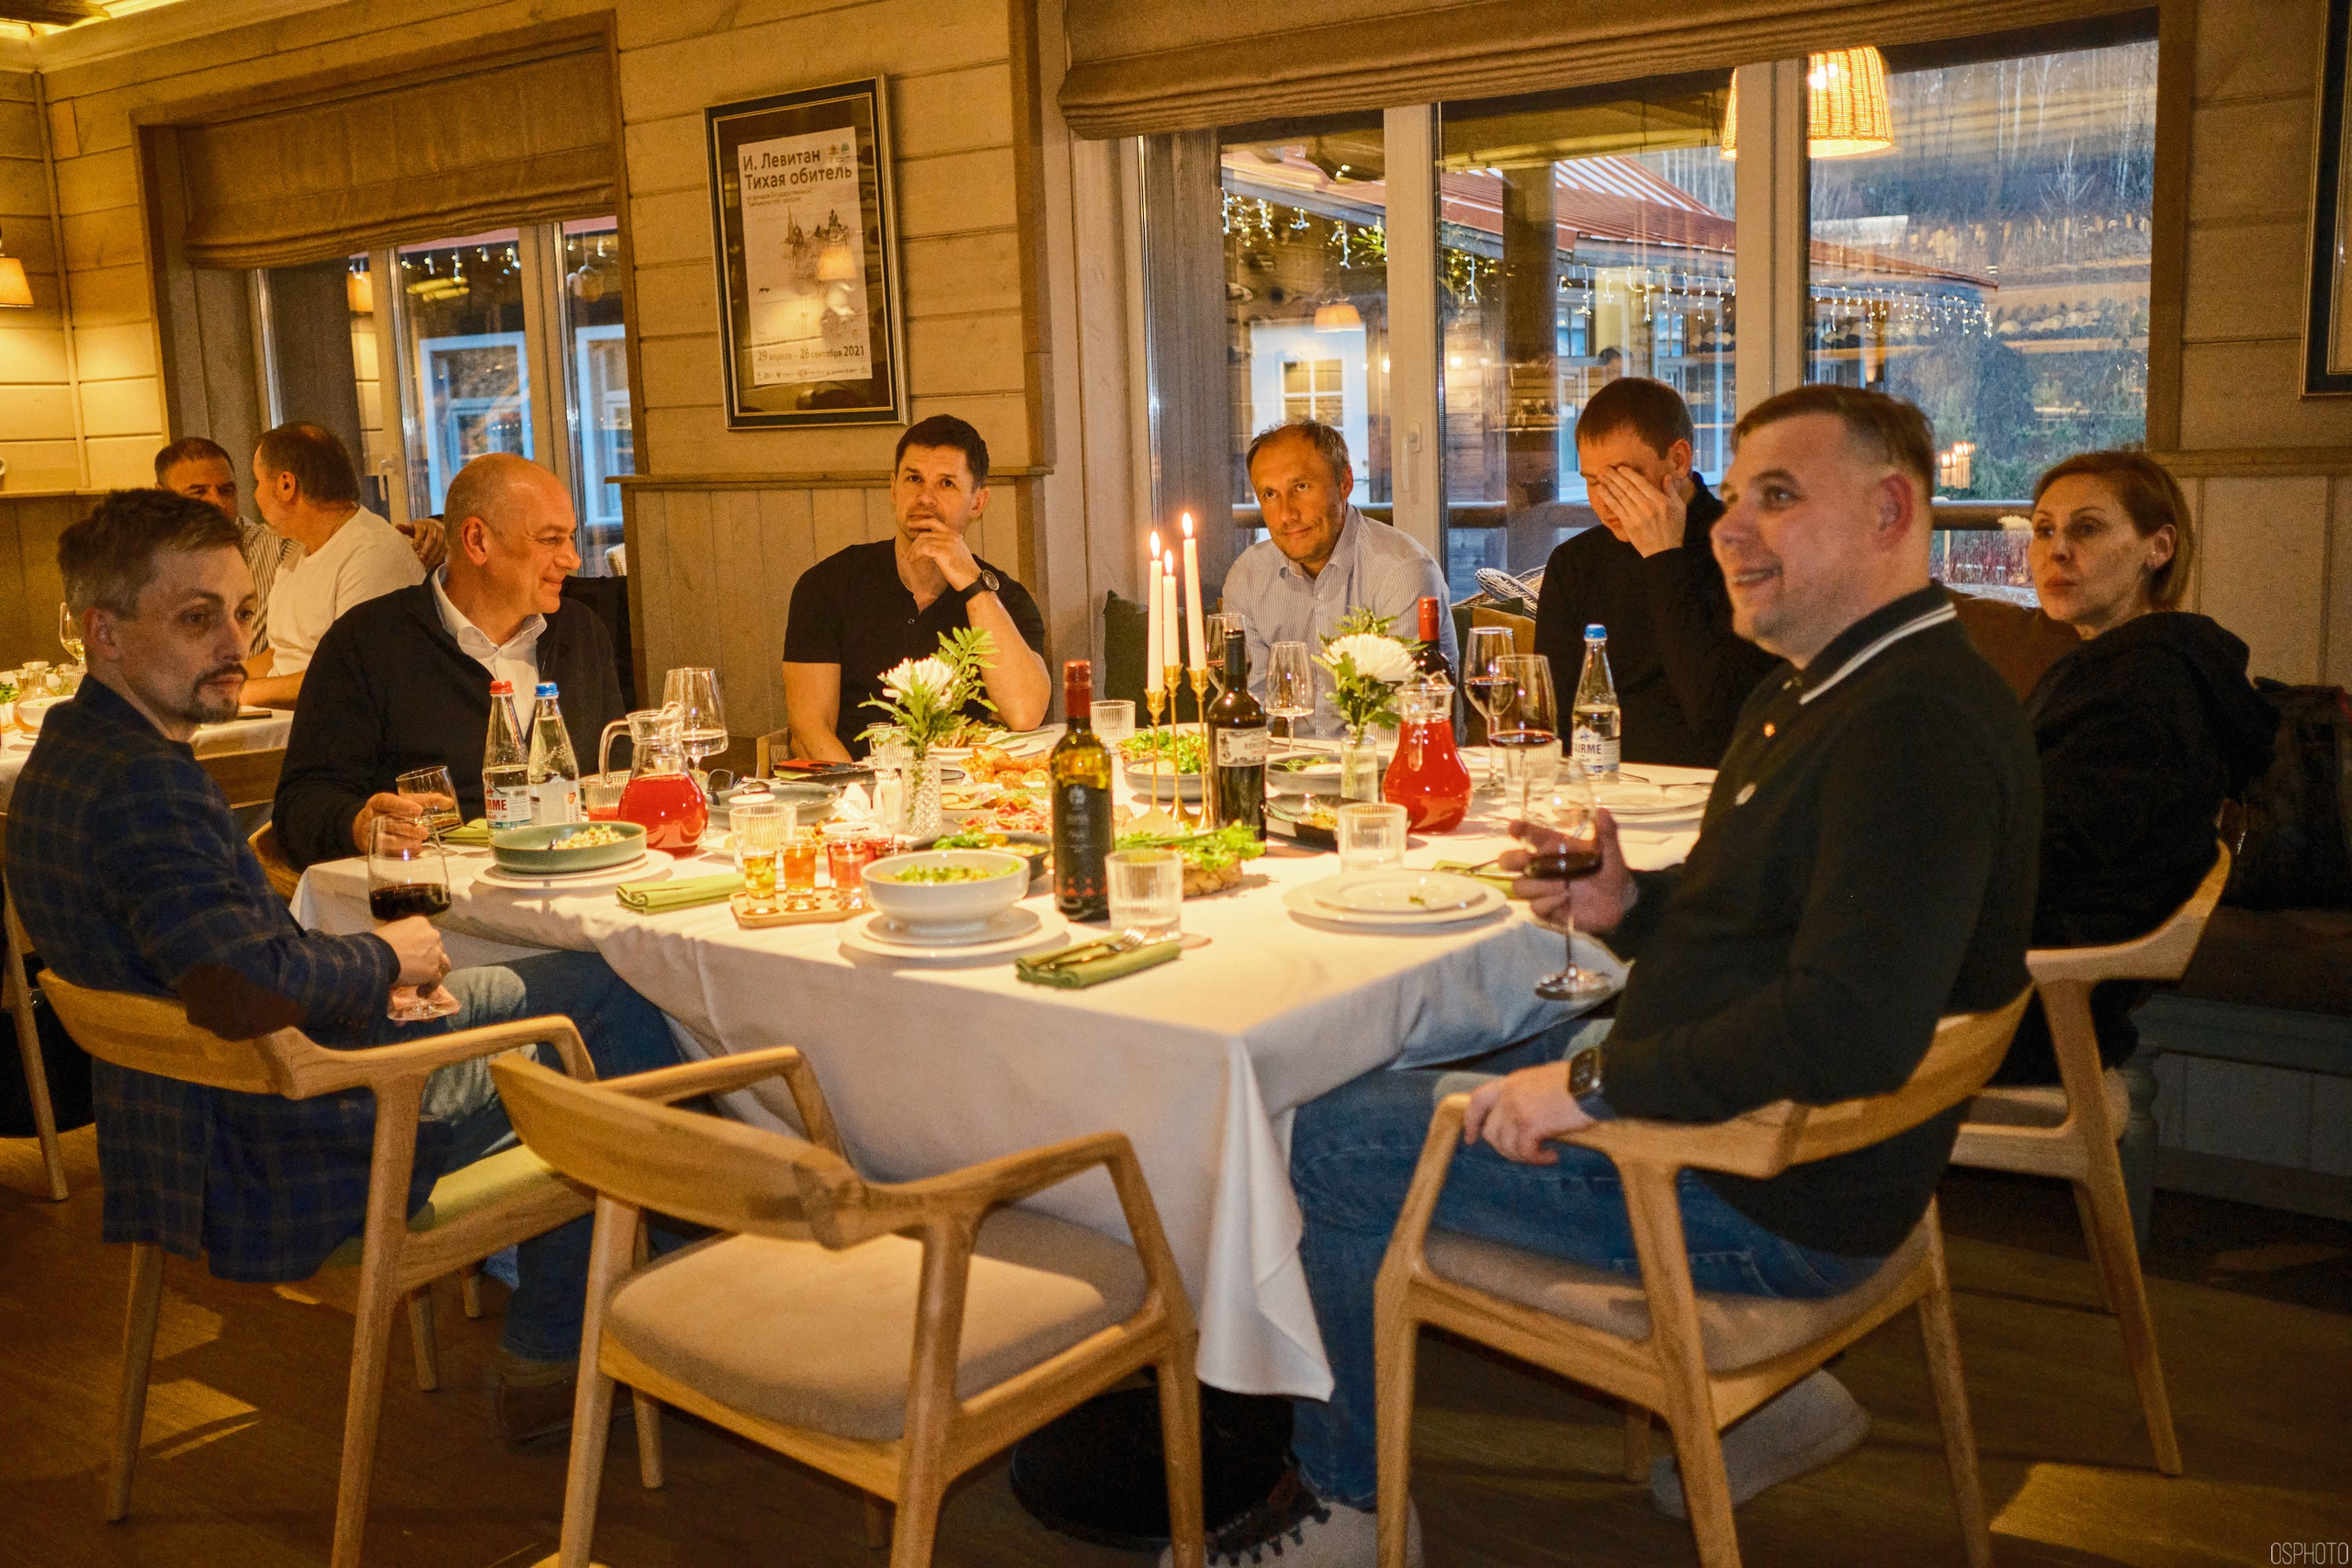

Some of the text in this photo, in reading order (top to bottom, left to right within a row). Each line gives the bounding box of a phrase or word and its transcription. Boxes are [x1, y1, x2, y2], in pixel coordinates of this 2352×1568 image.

[743, 155, 757, 171] И.
[762, 151, 820, 169] Левитан
[745, 167, 853, 190] Тихая обитель
[757, 350, 767, 362] 29
[799, 348, 809, 359] 26
[811, 348, 842, 359] сентября
[842, 345, 865, 357] 2021
